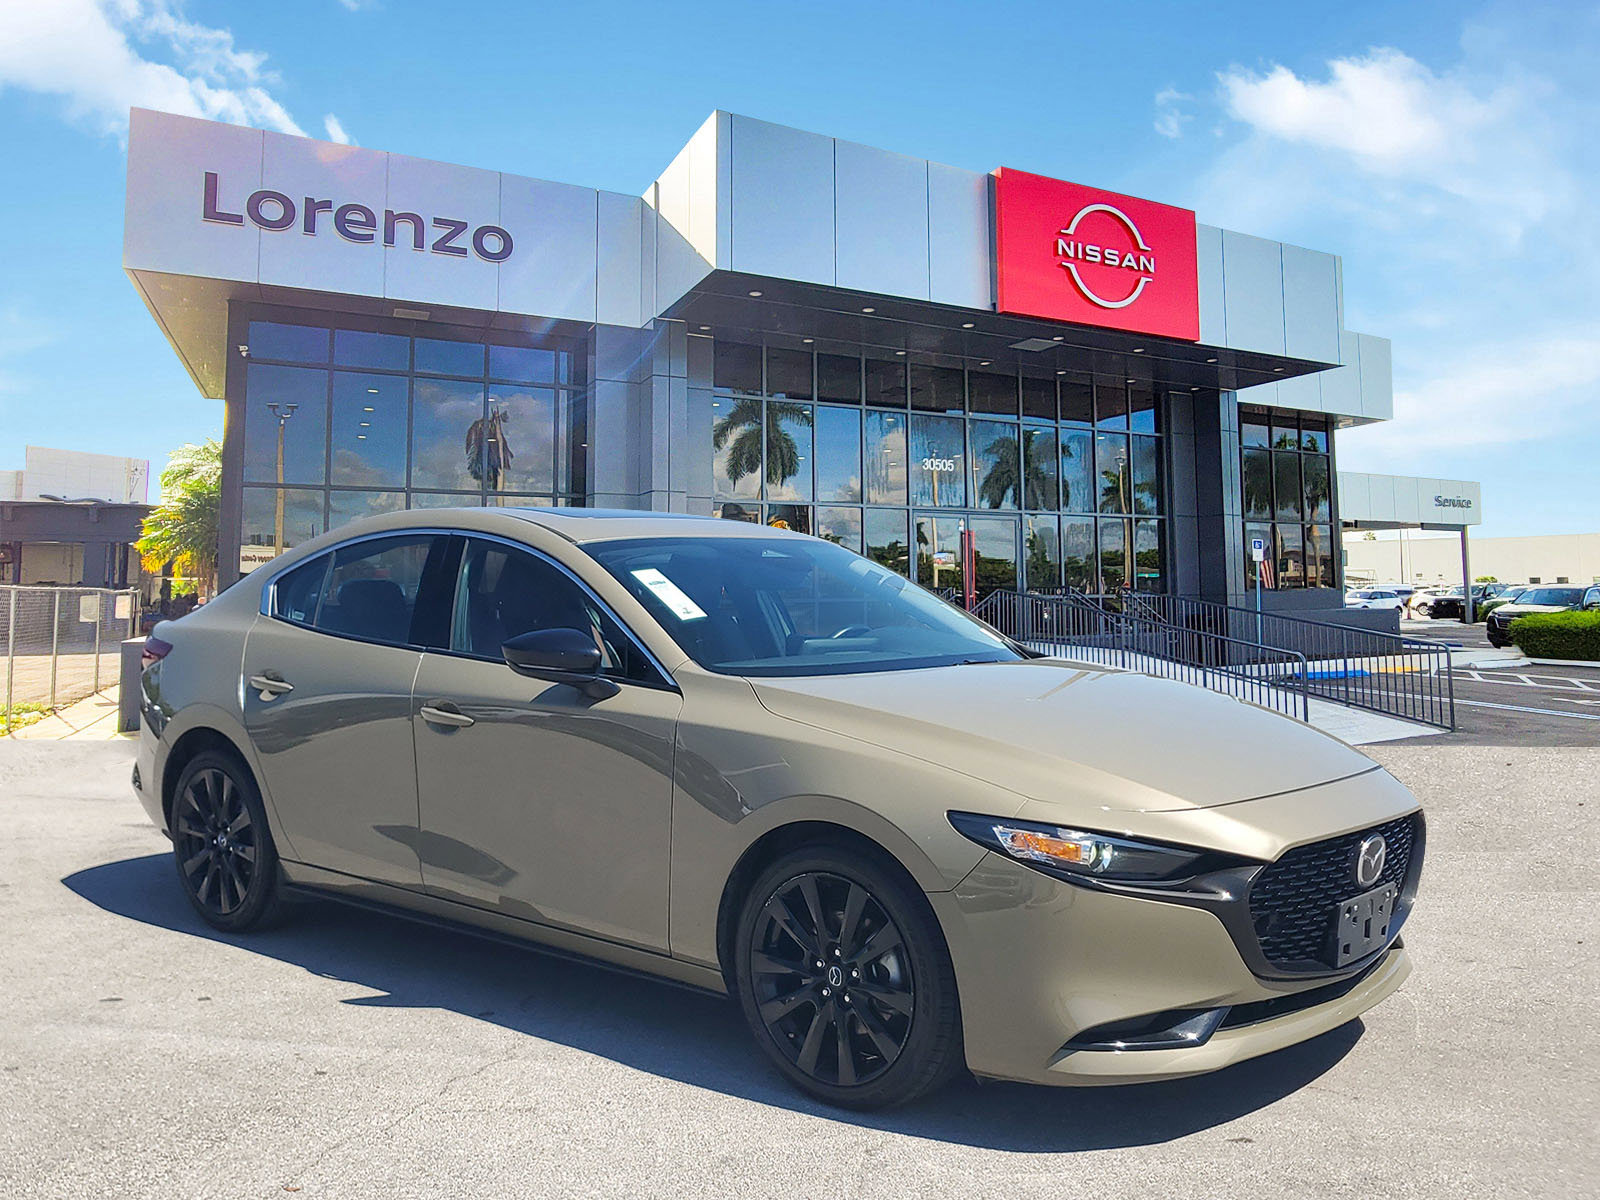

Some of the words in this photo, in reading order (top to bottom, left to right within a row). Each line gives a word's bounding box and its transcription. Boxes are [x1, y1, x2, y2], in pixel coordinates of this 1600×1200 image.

[203, 171, 514, 262] Lorenzo
[1057, 238, 1155, 273] NISSAN
[922, 457, 955, 472] 30505
[1434, 495, 1472, 509] Service
